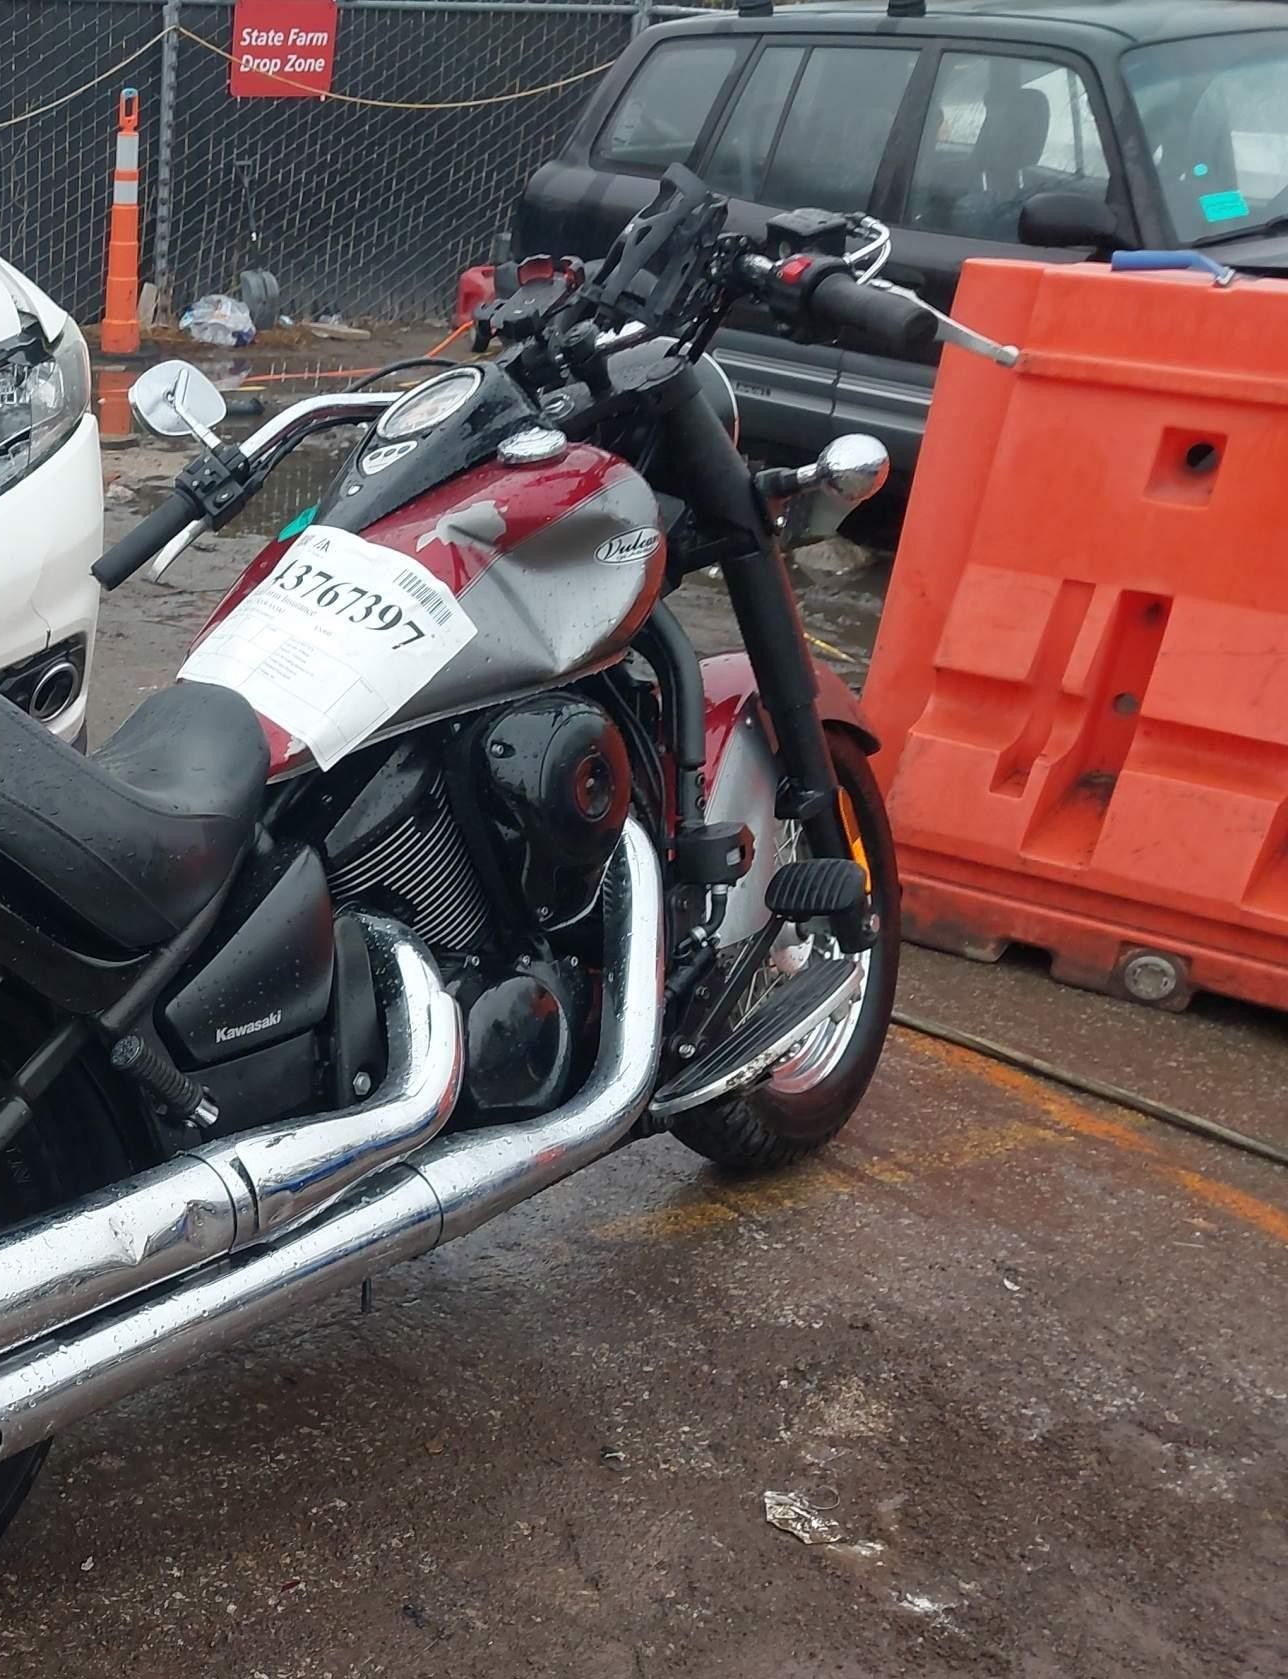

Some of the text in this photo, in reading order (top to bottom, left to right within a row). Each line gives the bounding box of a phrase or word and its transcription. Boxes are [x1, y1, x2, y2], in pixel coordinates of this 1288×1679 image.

[240, 28, 328, 46] State Farm
[240, 54, 325, 76] Drop Zone
[215, 1009, 282, 1043] Kawasaki
